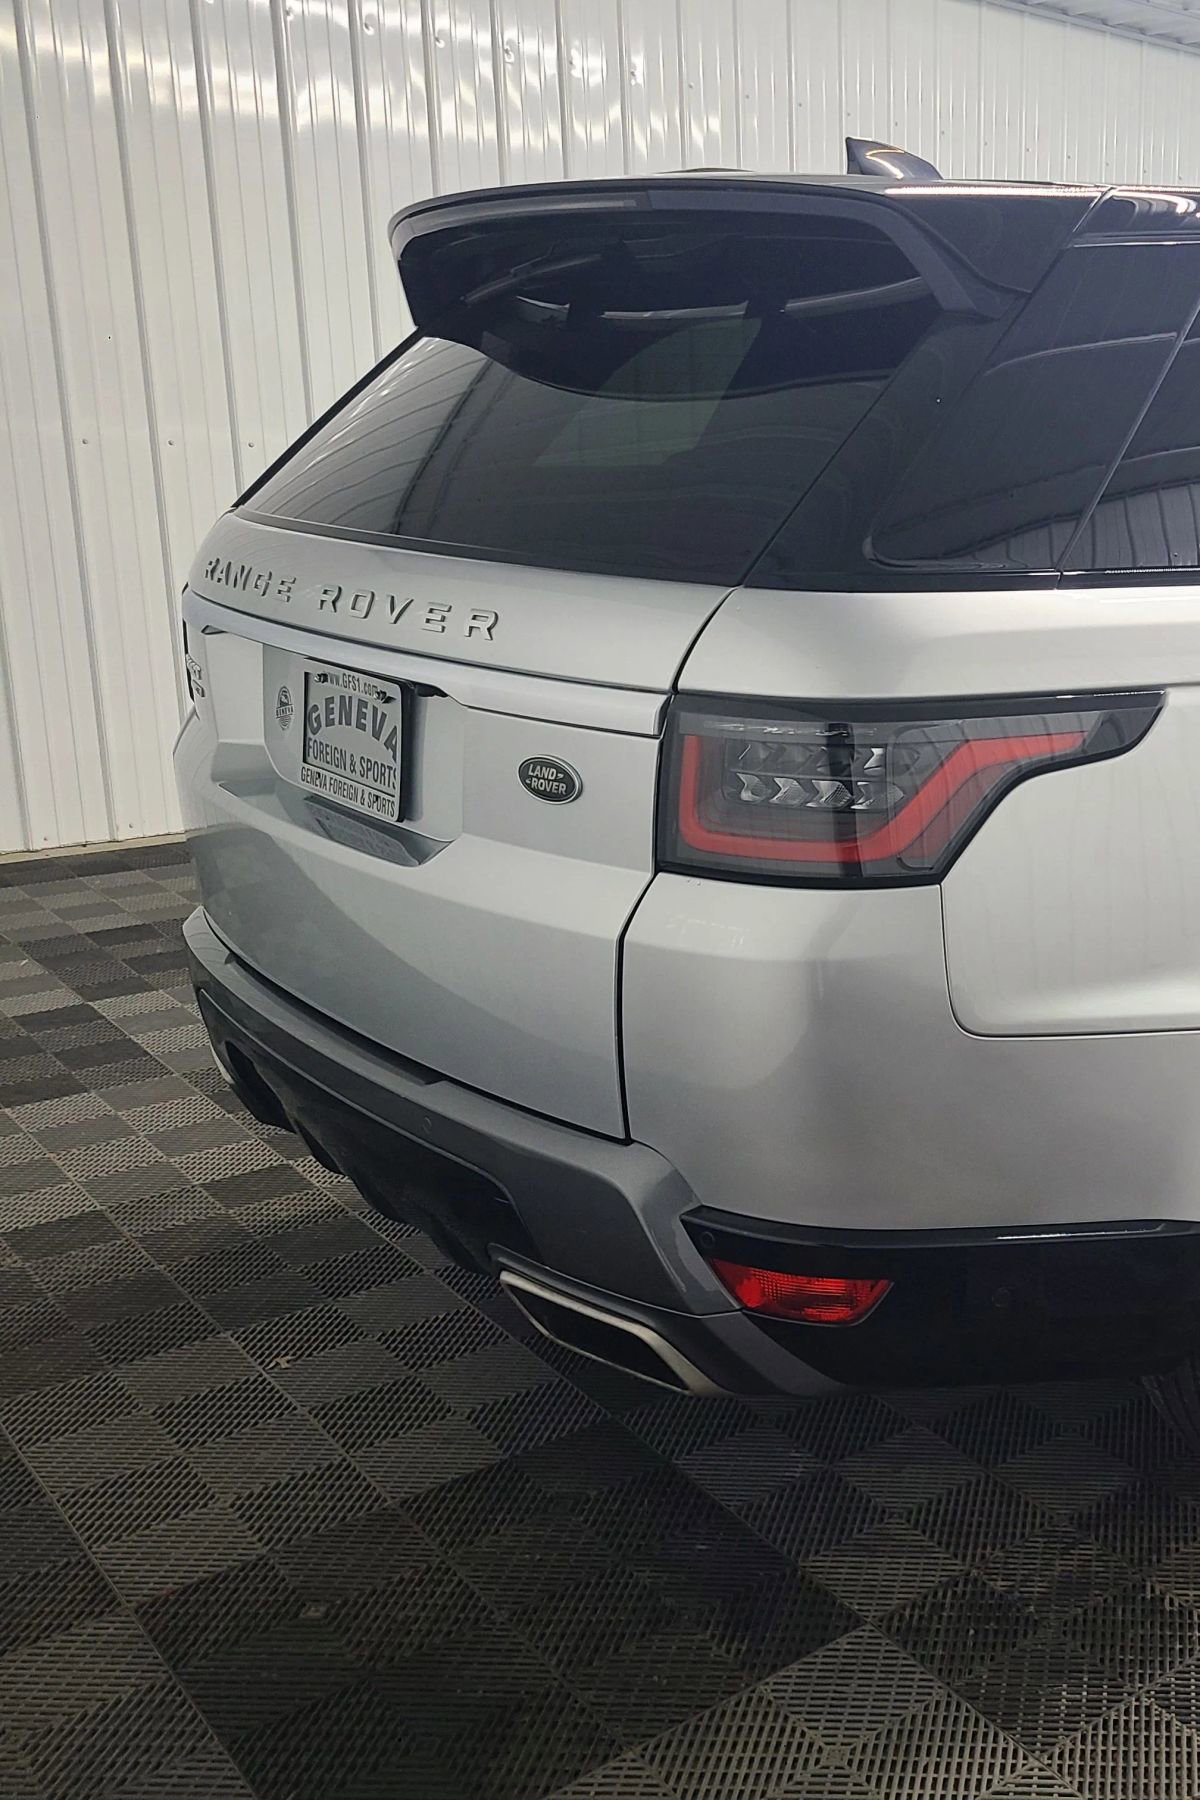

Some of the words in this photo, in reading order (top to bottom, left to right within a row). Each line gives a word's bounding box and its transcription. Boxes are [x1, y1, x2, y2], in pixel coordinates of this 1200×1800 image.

[205, 558, 296, 602] RANGE
[318, 584, 499, 641] ROVER
[308, 694, 398, 763] GENEVA
[307, 737, 347, 771] FOREIGN
[350, 753, 357, 775] &
[528, 763, 557, 780] LAND
[301, 766, 328, 791] GENEVA
[329, 776, 359, 804] FOREIGN
[360, 788, 366, 806] &
[367, 791, 396, 818] SPORTS
[531, 777, 567, 795] ROVER
